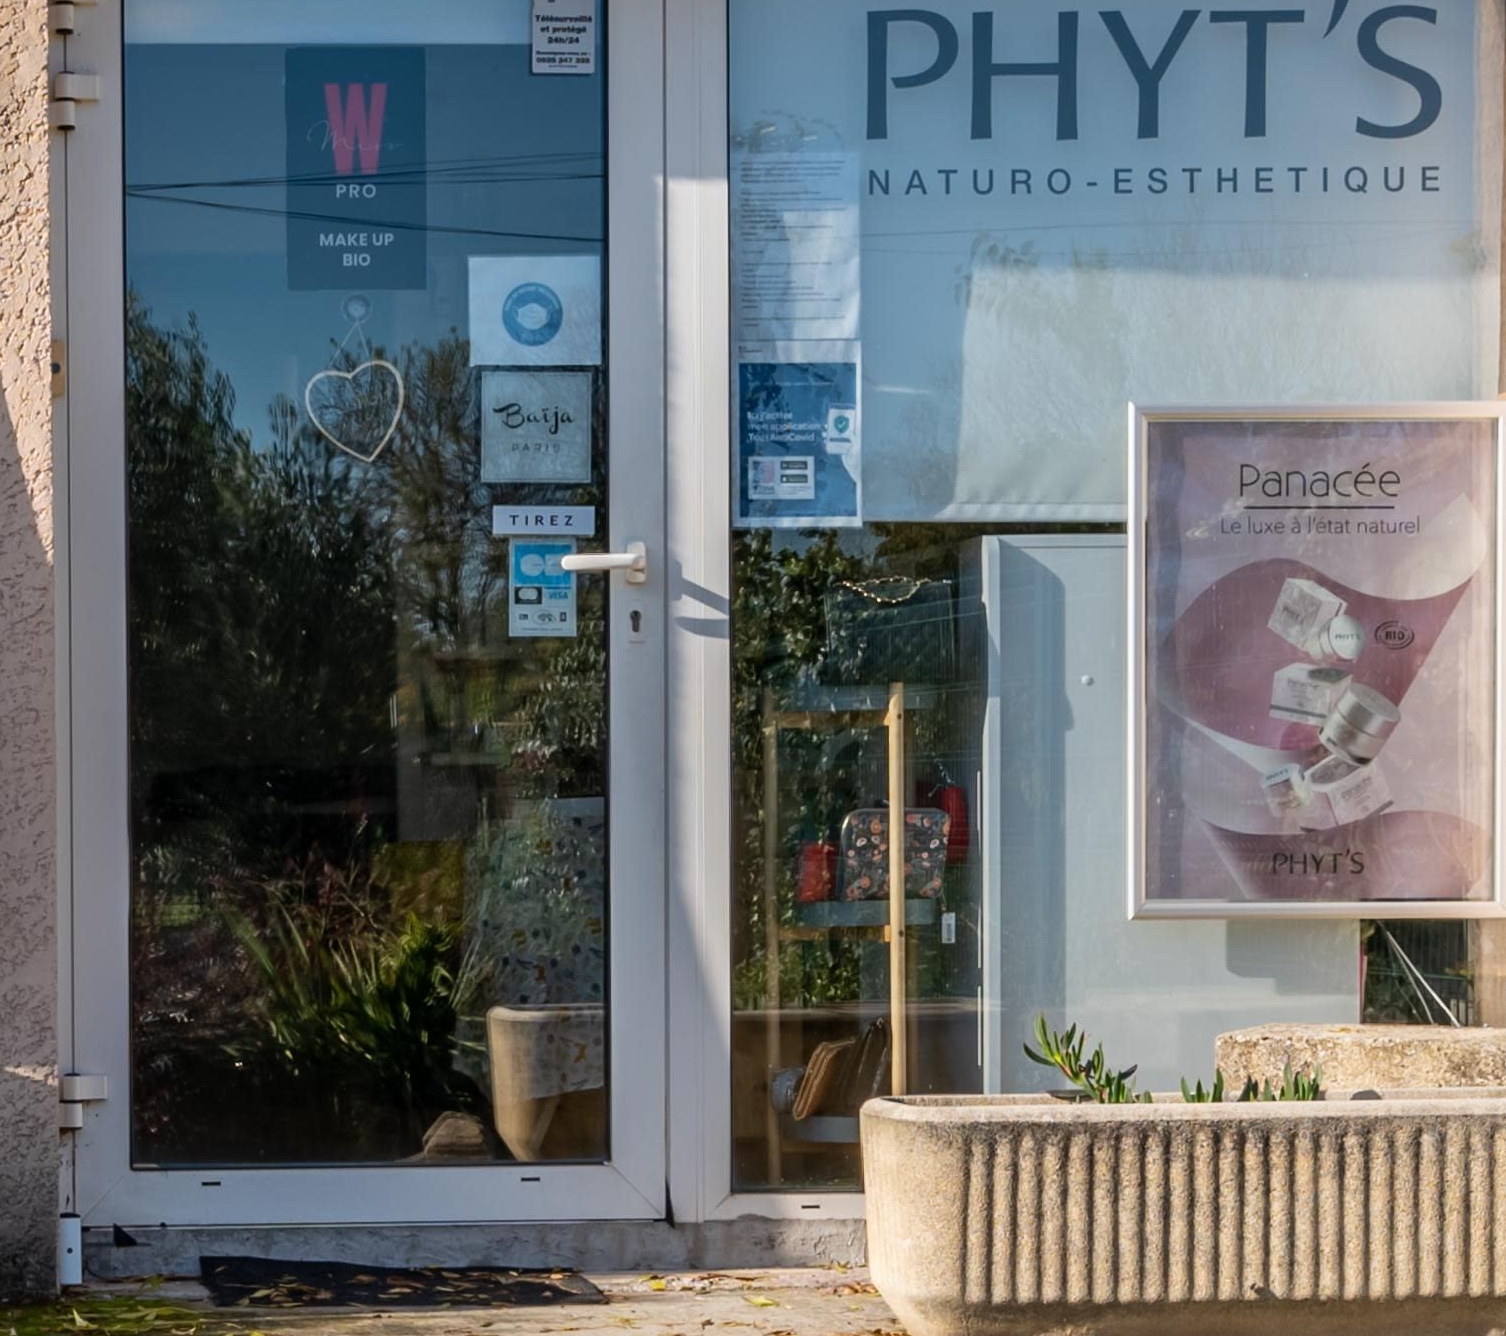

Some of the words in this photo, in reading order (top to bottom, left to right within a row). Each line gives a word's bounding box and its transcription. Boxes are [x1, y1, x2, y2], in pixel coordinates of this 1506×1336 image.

[540, 25, 550, 33] et
[547, 36, 579, 44] 24h/24
[324, 83, 388, 176] W
[867, 165, 1442, 196] NATURO-ESTHETIQUE
[336, 183, 377, 198] PRO
[319, 232, 368, 246] MAKE
[372, 232, 394, 246] UP
[342, 253, 371, 267] BIO
[492, 402, 575, 435] Baïja
[511, 443, 561, 453] PARIS
[1239, 463, 1401, 497] Panacée
[509, 514, 575, 526] TIREZ
[1220, 518, 1242, 534] Le
[1247, 516, 1285, 534] luxe
[1290, 518, 1302, 534] à
[1307, 516, 1352, 534] l'état
[1356, 515, 1420, 534] naturel
[1272, 849, 1365, 875] PHYT'S
